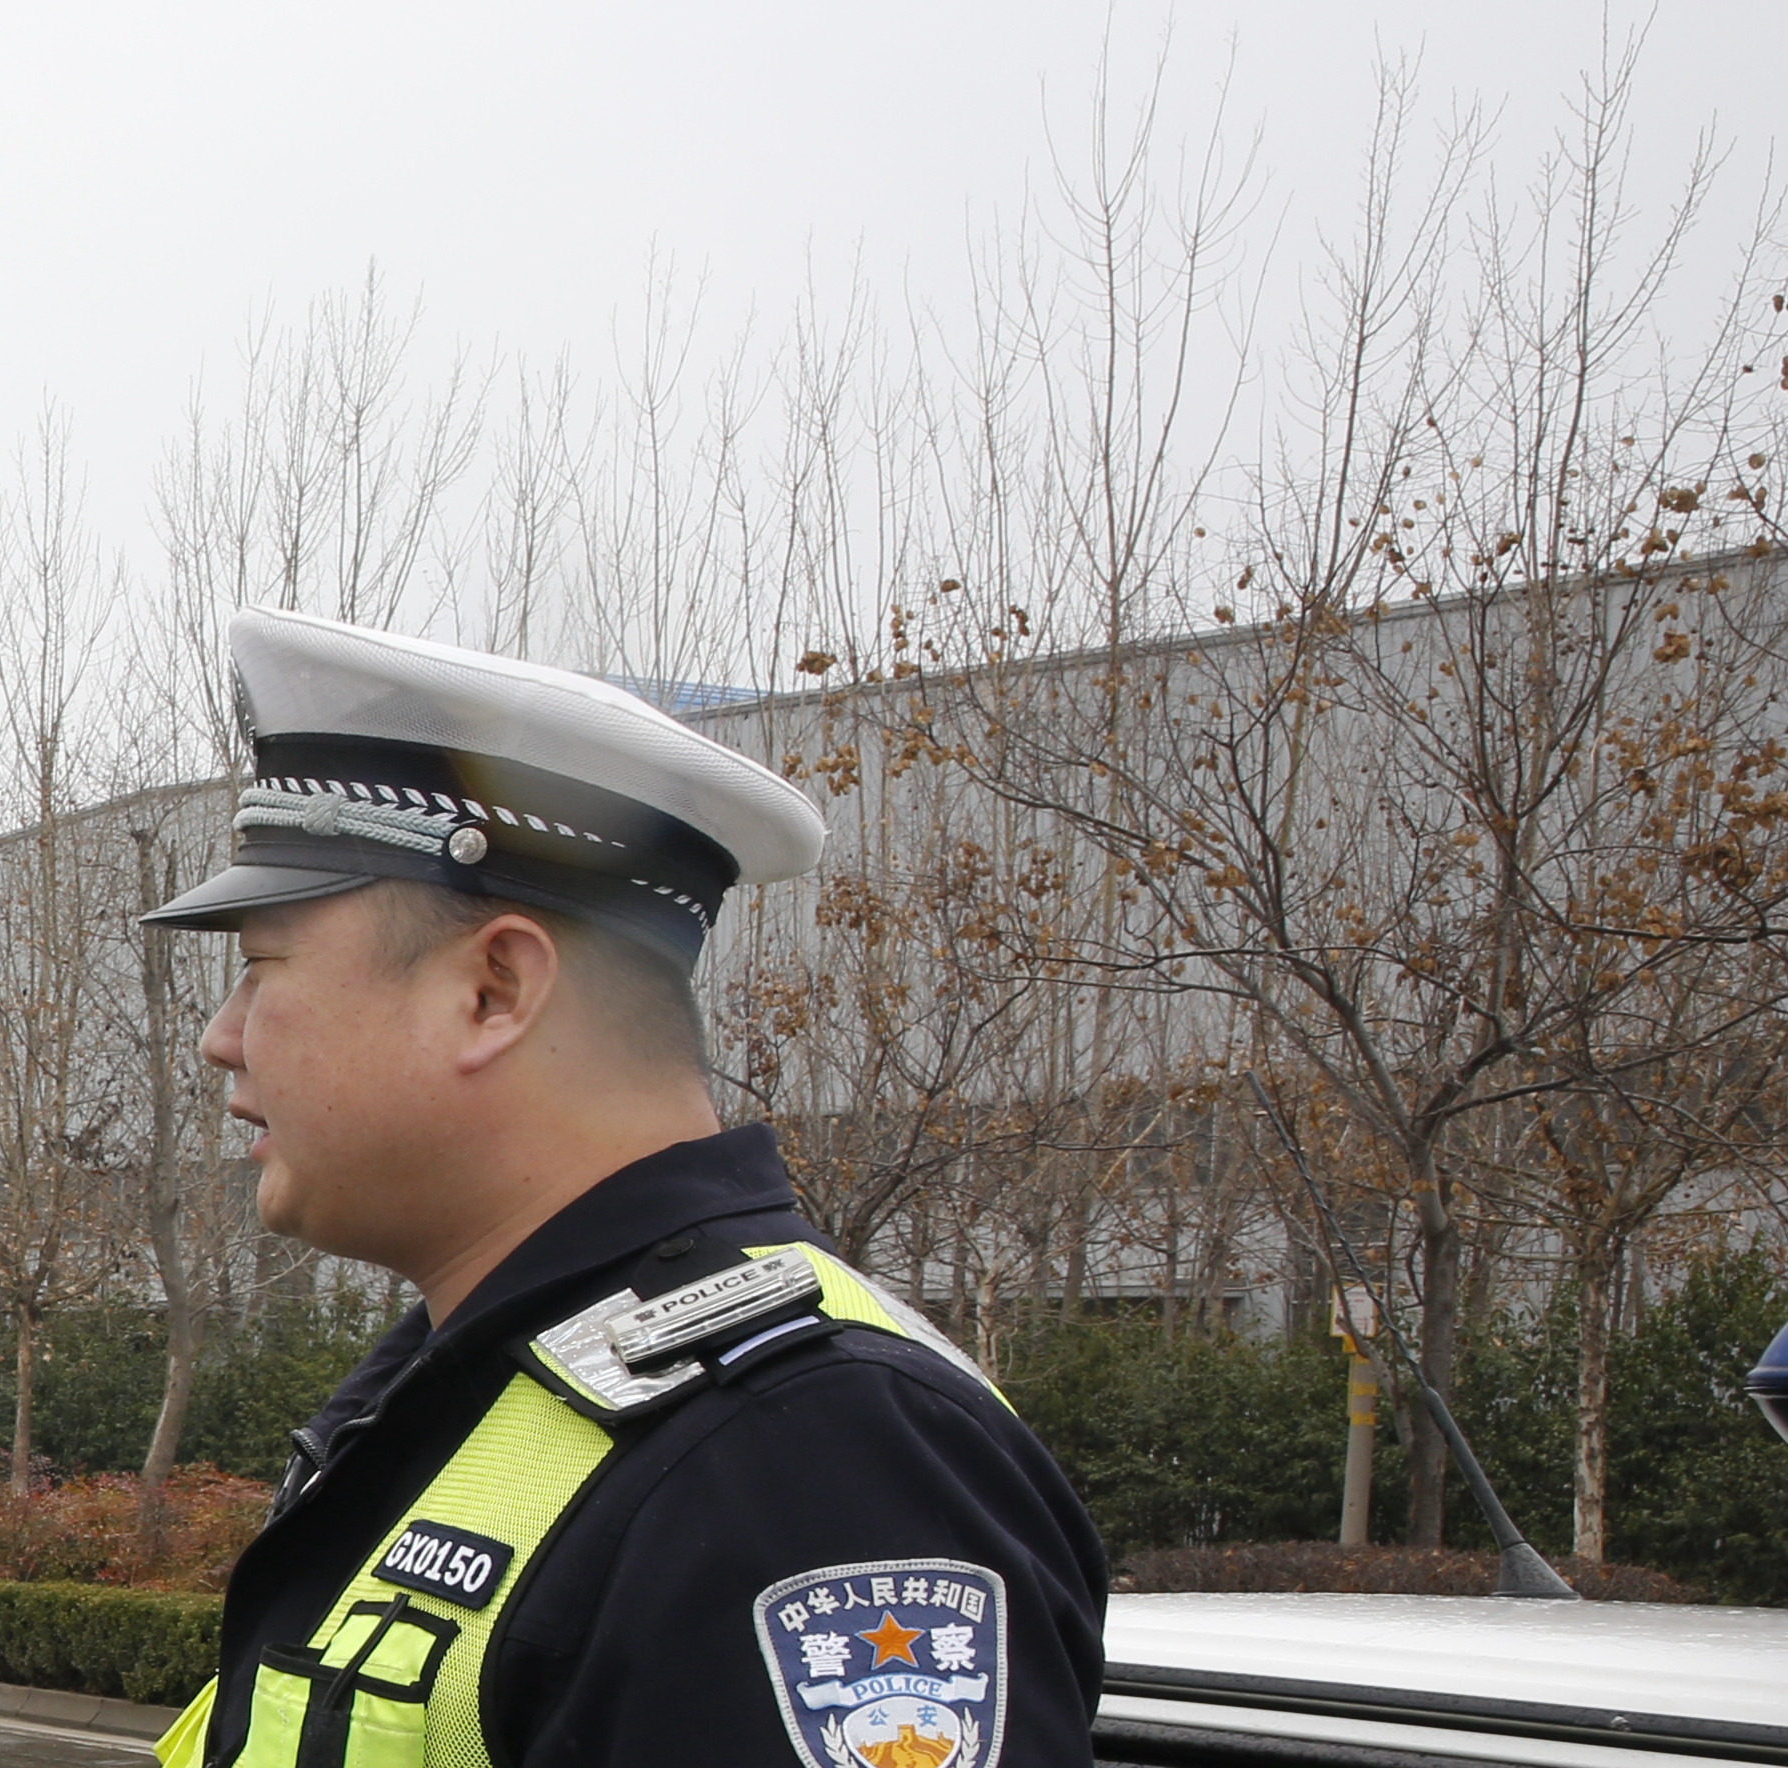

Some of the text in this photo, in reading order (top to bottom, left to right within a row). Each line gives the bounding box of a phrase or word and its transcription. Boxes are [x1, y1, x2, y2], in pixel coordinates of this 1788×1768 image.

[661, 1268, 760, 1314] POLICE
[778, 1576, 987, 1633] 中华人民共和国
[799, 1623, 976, 1678] 警 察
[851, 1677, 943, 1701] POLICE
